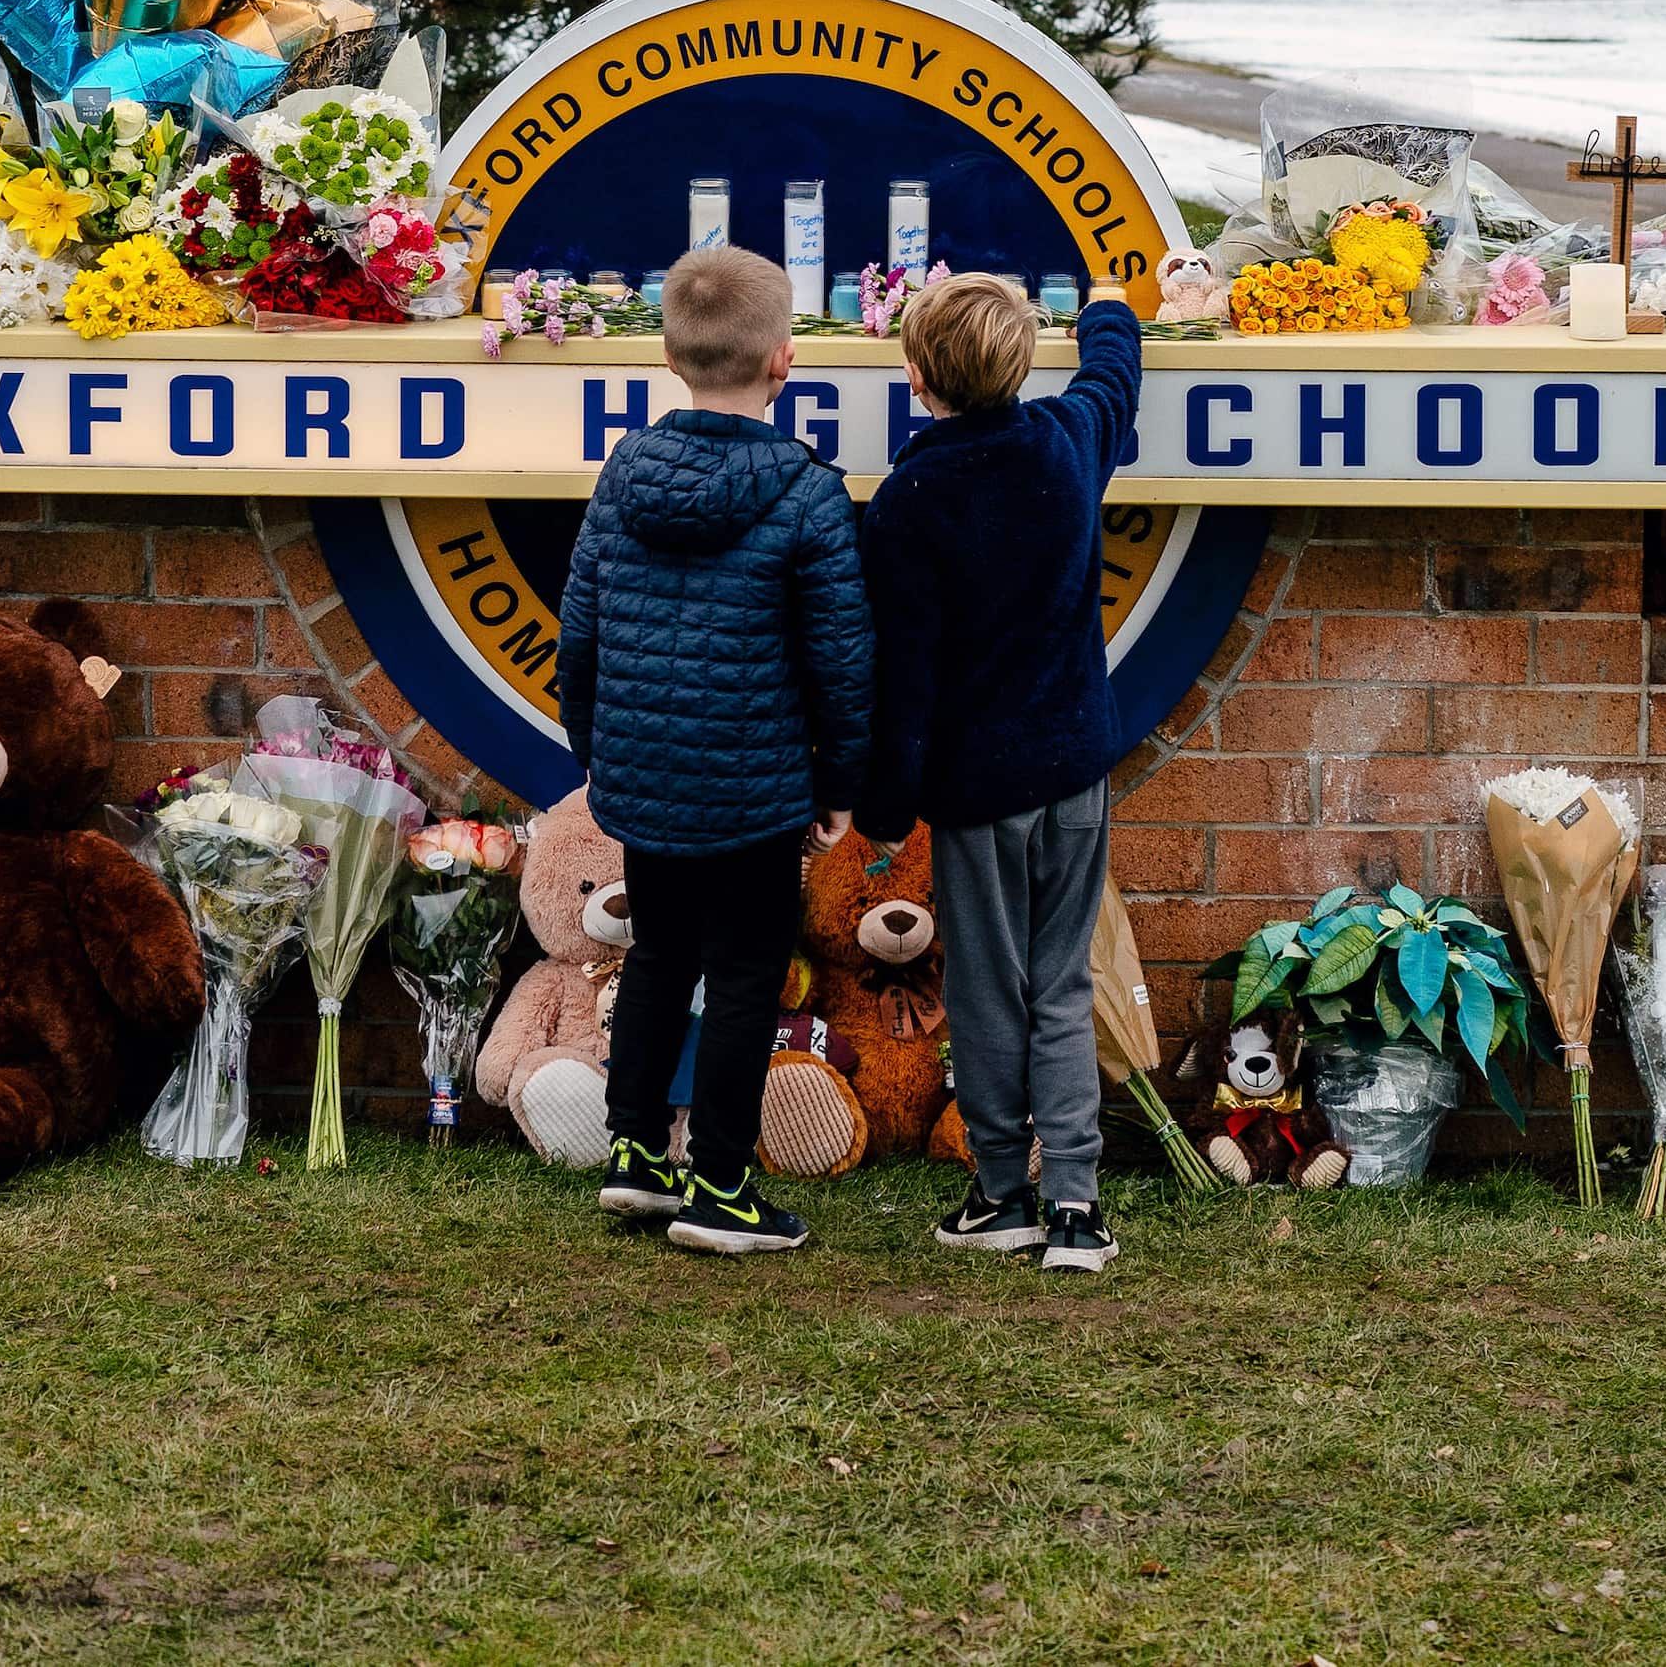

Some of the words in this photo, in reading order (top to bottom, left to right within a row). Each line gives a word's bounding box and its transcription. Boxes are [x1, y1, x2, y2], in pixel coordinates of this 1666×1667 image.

[441, 92, 583, 250] XFORD
[598, 19, 942, 97] COMMUNITY
[952, 69, 1148, 284] SCHOOLS
[582, 378, 935, 466] HGH
